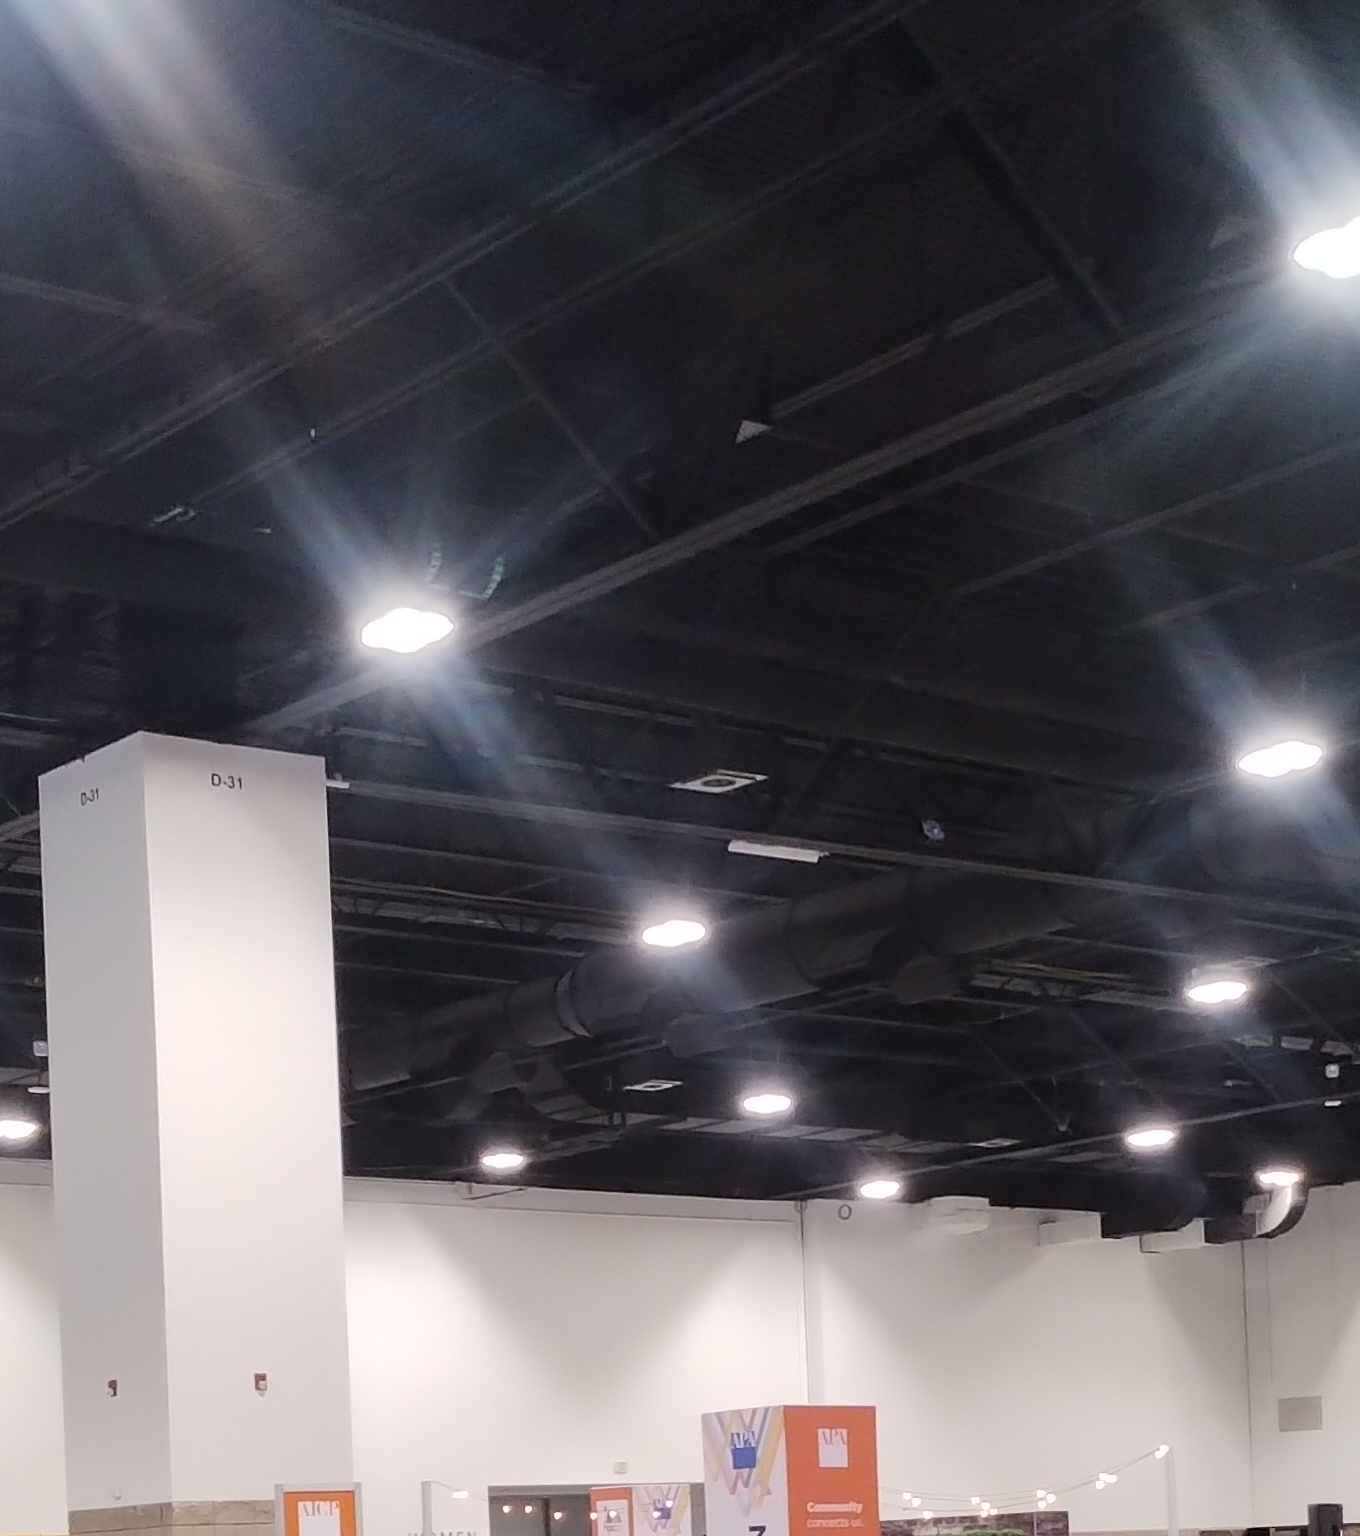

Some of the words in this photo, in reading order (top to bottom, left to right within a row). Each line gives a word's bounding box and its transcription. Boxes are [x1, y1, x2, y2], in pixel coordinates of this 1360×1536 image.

[211, 773, 243, 790] D-31
[730, 1430, 757, 1448] APA
[819, 1428, 848, 1445] APA
[300, 1501, 340, 1517] AICP
